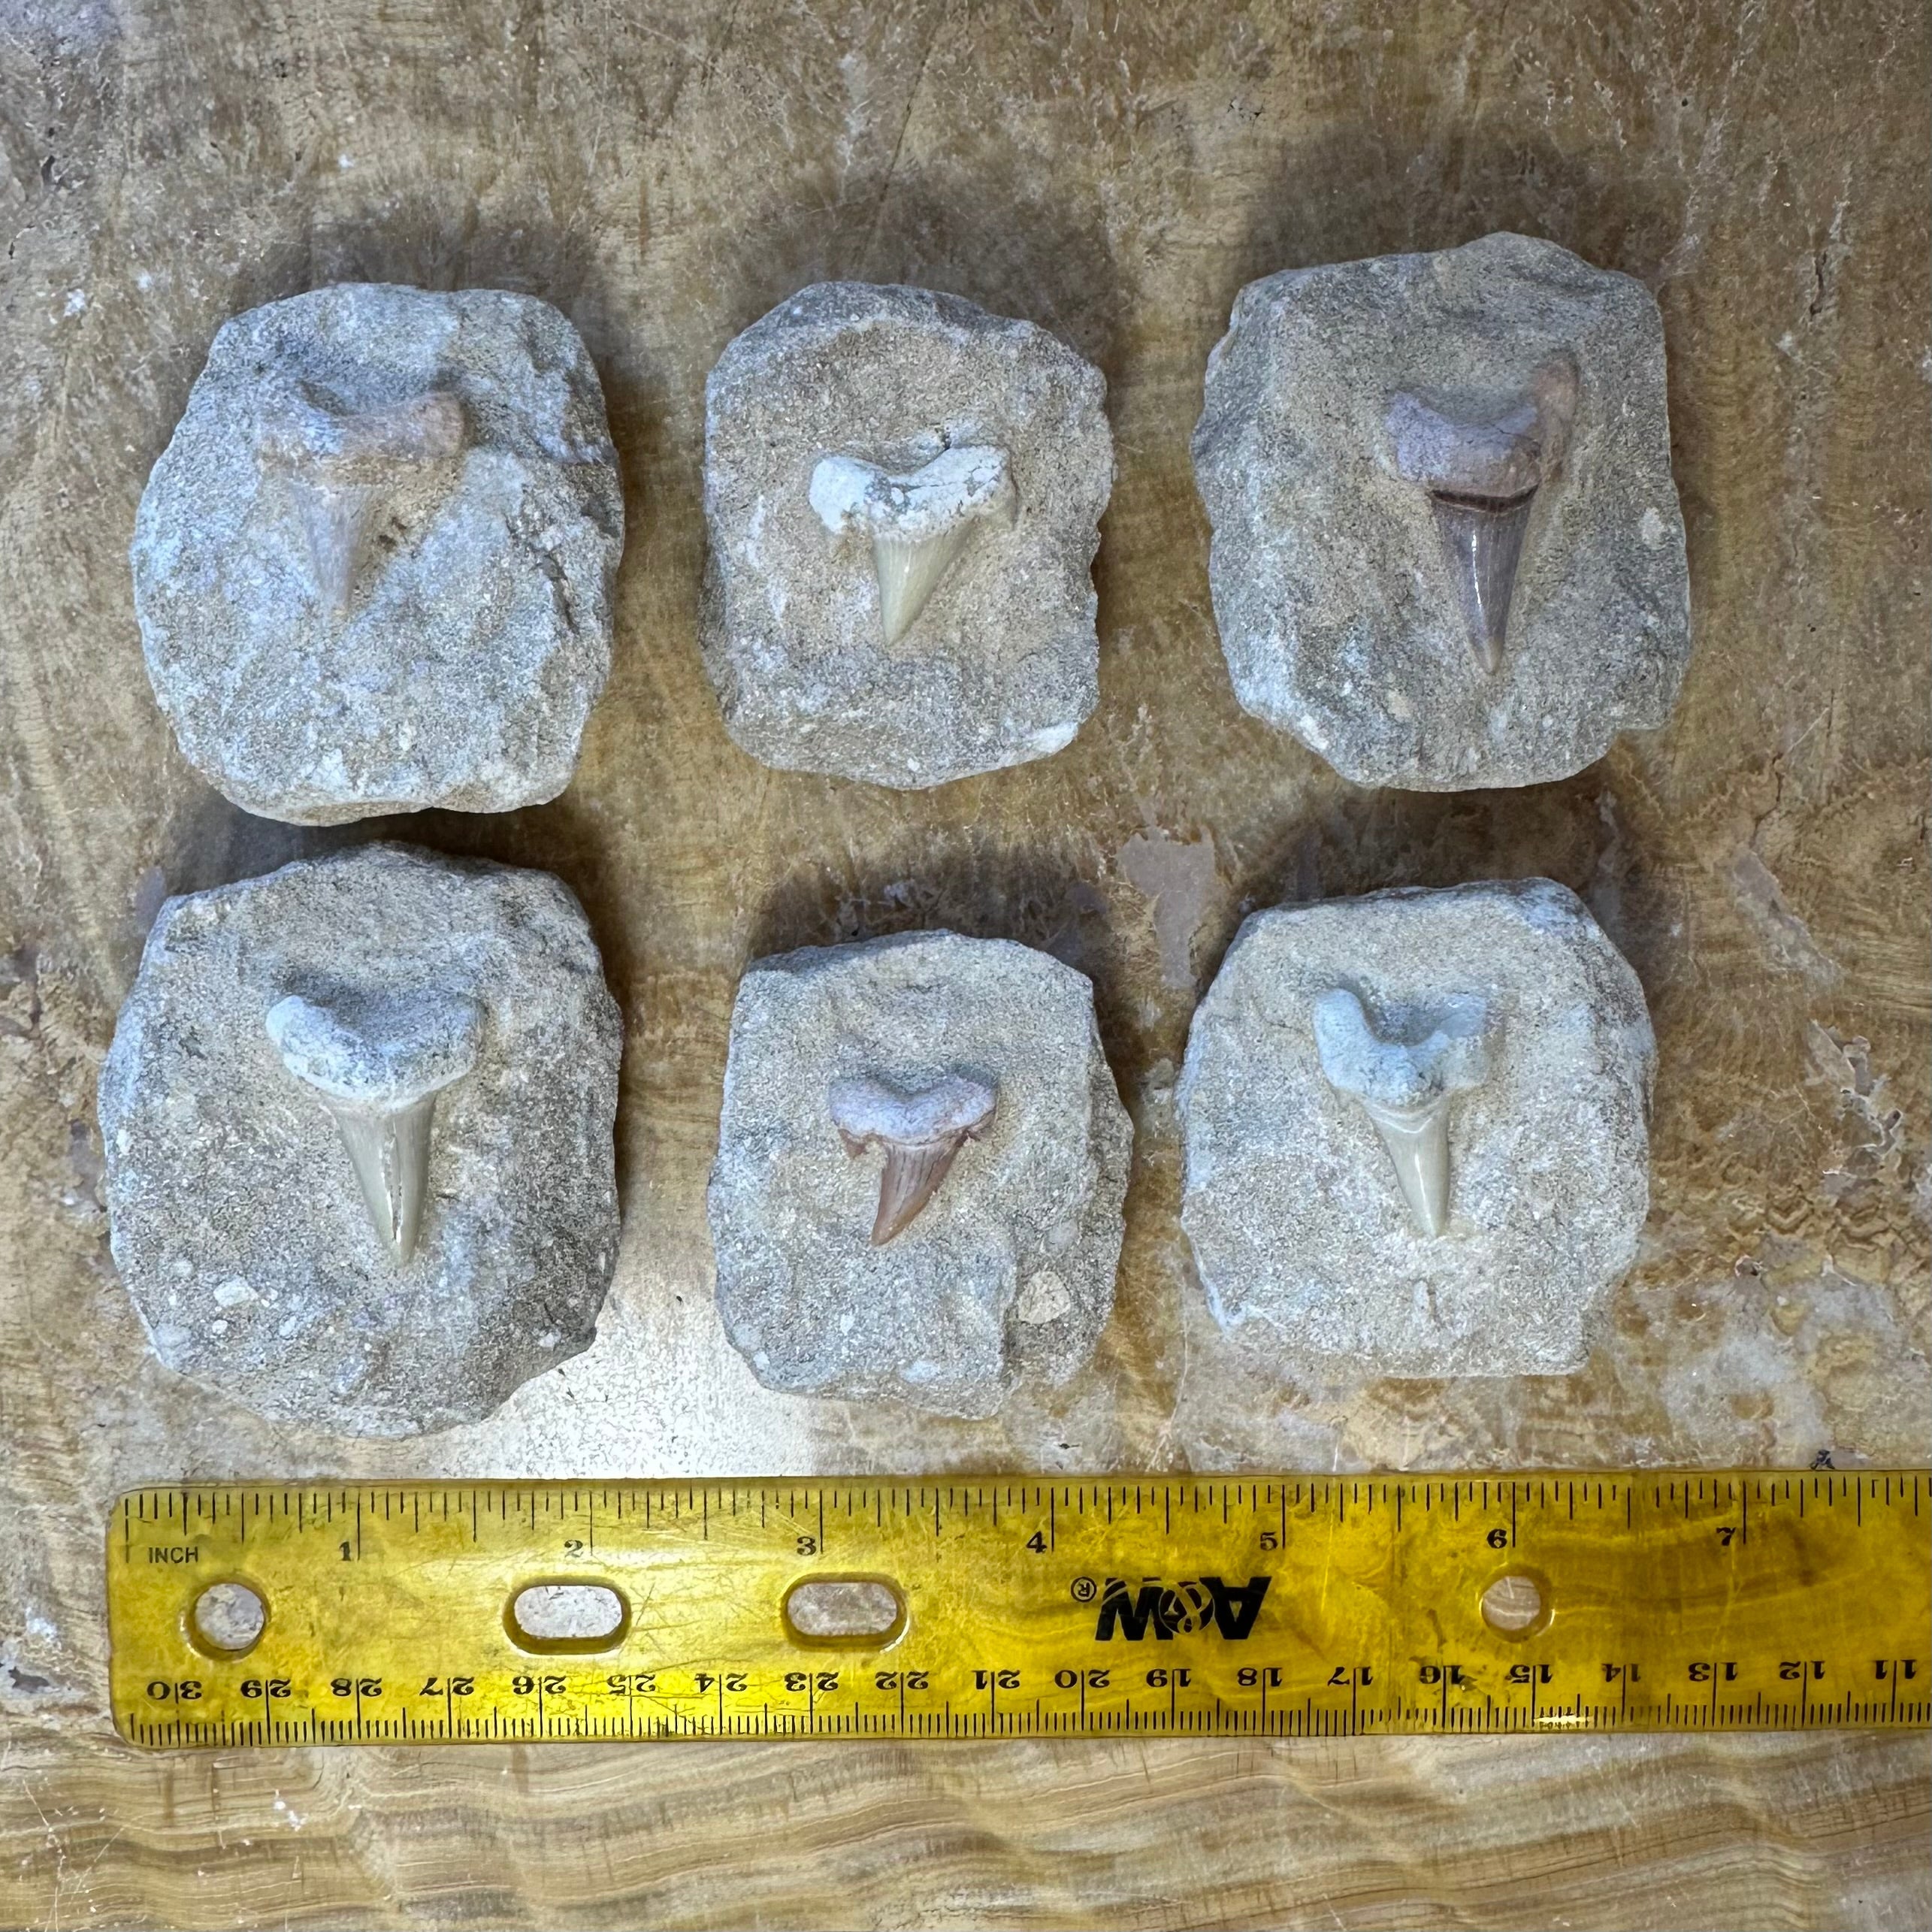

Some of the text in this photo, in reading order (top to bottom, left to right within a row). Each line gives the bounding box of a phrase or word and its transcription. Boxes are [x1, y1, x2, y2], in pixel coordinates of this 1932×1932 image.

[148, 1527, 1737, 1564] INCH 1 2 3 4 5 6 7
[147, 1659, 1918, 1701] 11 12 13 14 15 16 17 18 19 20 21 22 23 24 25 26 27 28 29 30
